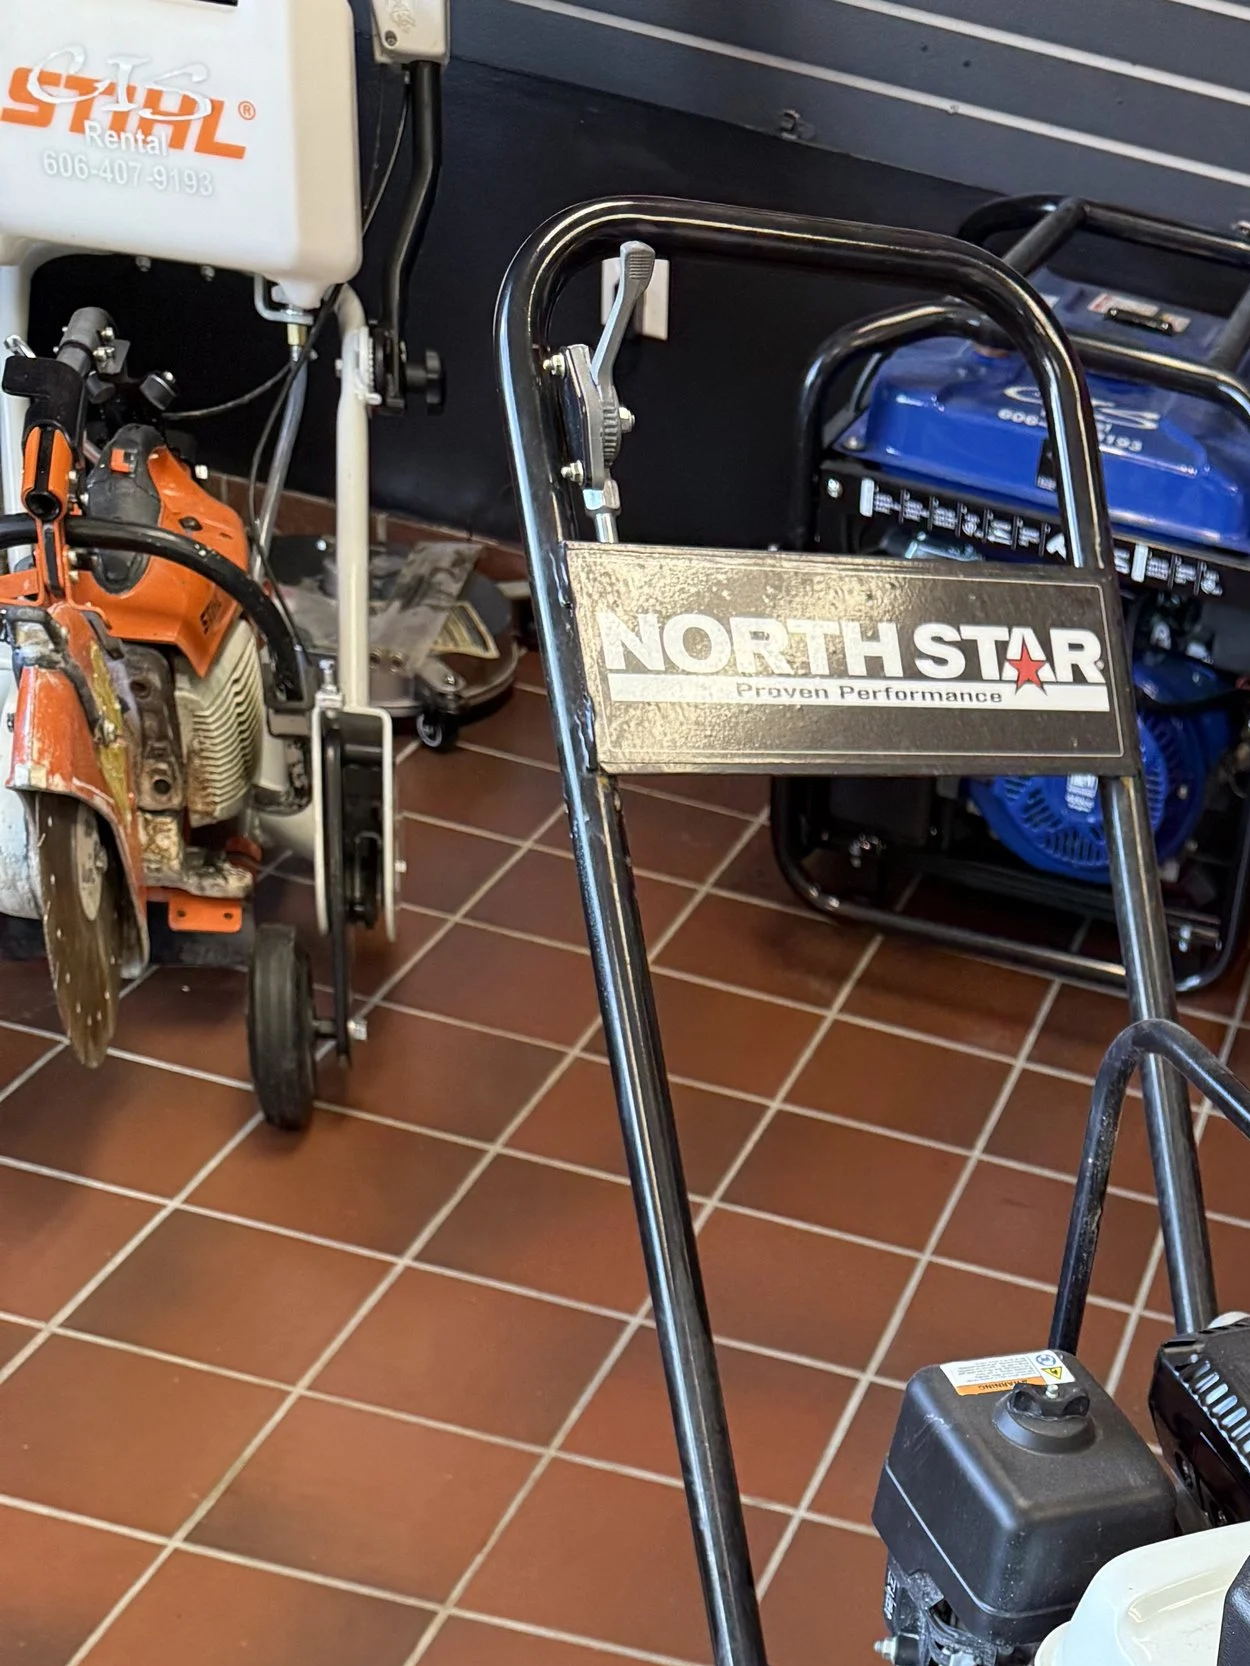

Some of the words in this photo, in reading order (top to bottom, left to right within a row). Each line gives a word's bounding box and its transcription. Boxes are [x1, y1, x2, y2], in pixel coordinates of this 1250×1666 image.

[0, 66, 248, 160] STIHL
[83, 120, 170, 157] Rental
[43, 150, 213, 196] 606-407-9193
[736, 682, 829, 701] Proven
[840, 684, 1003, 704] Performance
